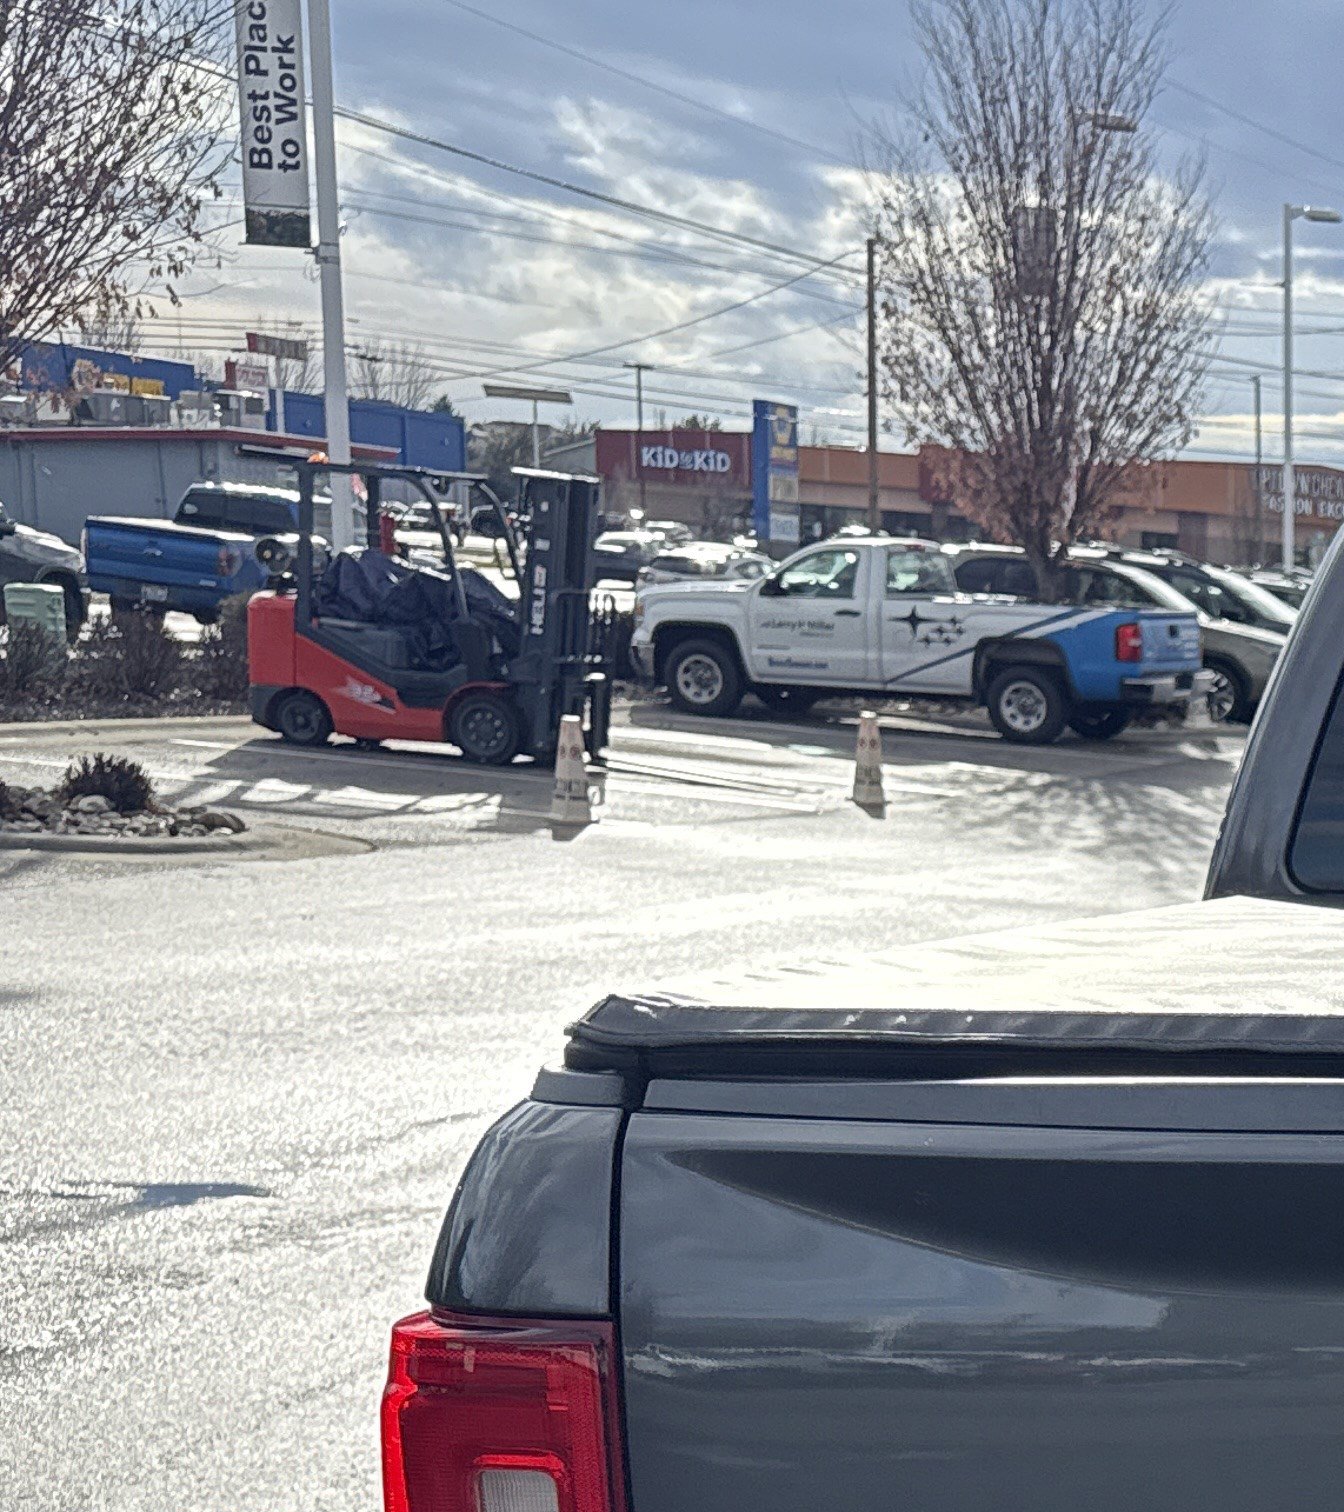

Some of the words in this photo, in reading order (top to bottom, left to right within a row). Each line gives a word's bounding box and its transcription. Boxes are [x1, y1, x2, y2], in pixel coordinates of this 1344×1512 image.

[243, 0, 269, 76] Plac
[271, 34, 298, 125] Work
[247, 90, 273, 169] Best
[277, 138, 300, 173] to
